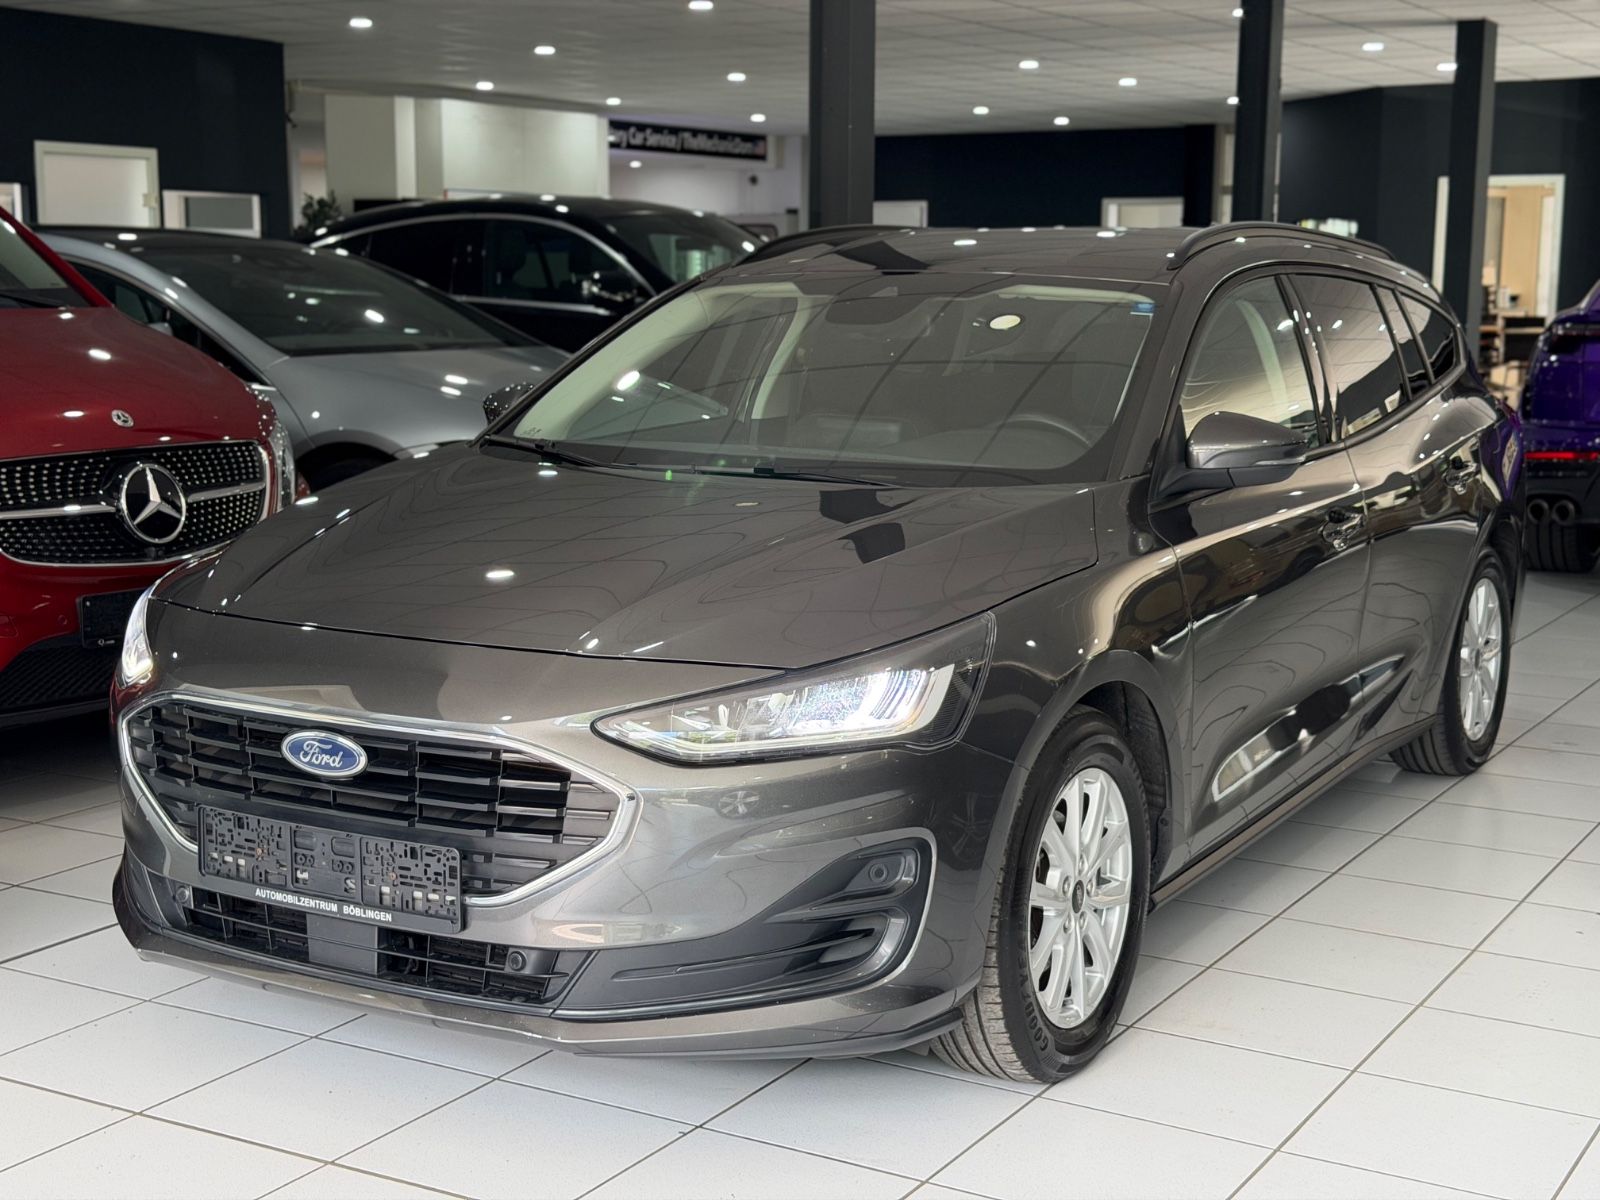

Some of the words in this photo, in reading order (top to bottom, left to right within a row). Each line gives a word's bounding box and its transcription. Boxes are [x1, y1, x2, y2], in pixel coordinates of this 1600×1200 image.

[628, 125, 645, 146] Car
[645, 128, 677, 148] Service
[300, 740, 344, 768] Ford
[255, 888, 338, 913] AUTOMOBILZENTRUM
[343, 905, 392, 922] BÖBLINGEN
